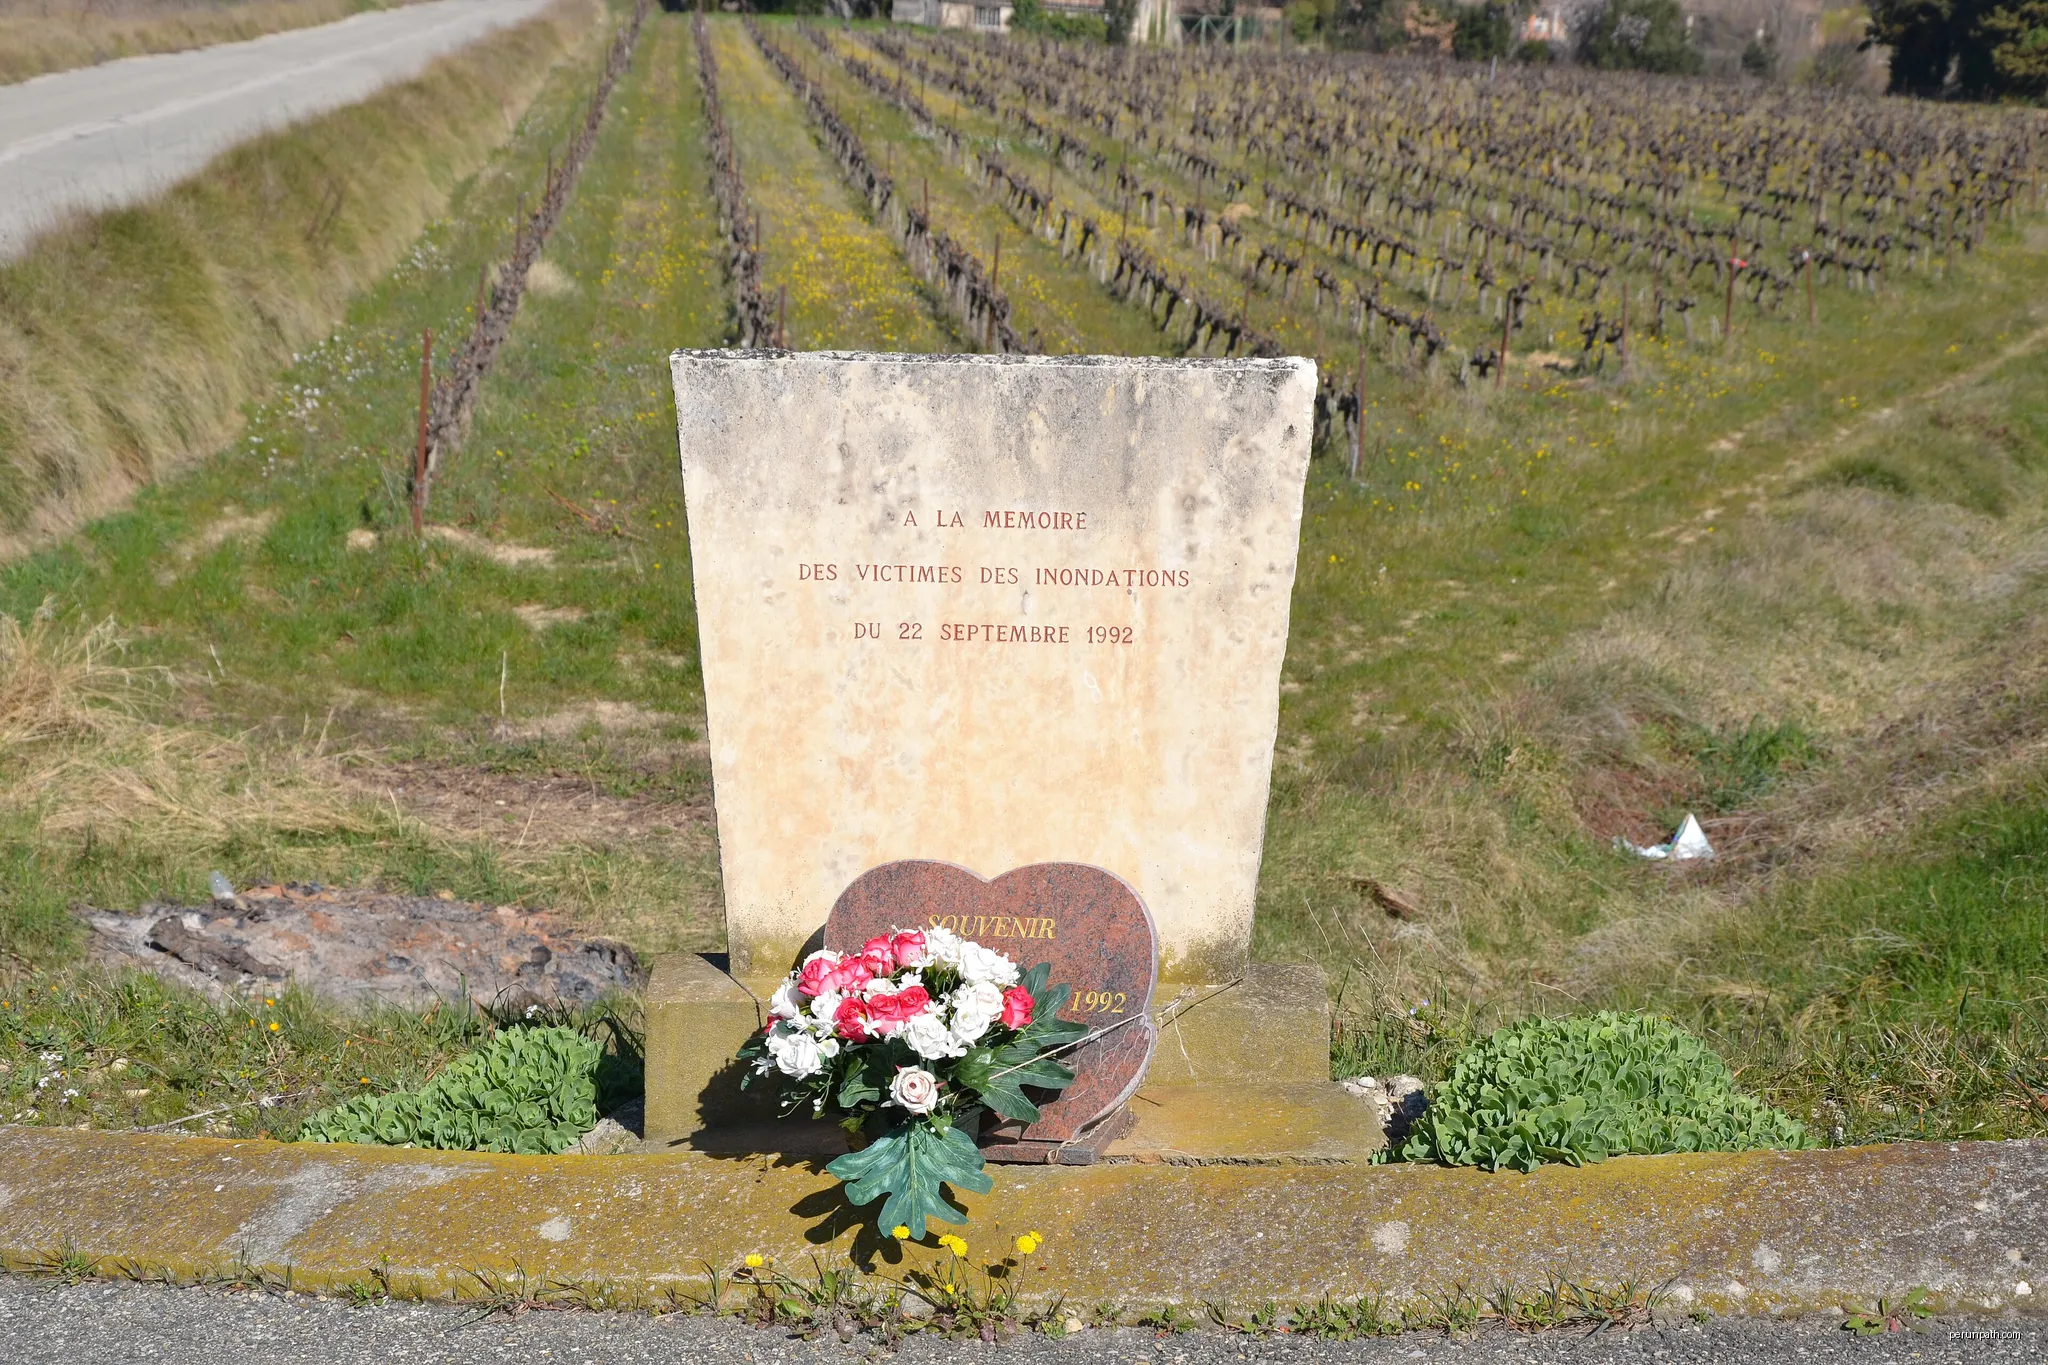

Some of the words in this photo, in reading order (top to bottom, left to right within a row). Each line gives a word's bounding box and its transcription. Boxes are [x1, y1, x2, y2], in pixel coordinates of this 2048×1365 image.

[903, 511, 918, 527] A
[936, 510, 964, 528] LA
[983, 510, 1087, 530] MEMOIRE
[799, 564, 838, 581] DES
[856, 565, 962, 583] VICTIMES
[980, 567, 1019, 585] DES
[1036, 568, 1189, 587] INONDATIONS
[854, 623, 881, 639] DU
[899, 623, 923, 640] 22
[940, 624, 1069, 643] SEPTEMBRE
[1087, 627, 1133, 644] 1992
[1071, 991, 1127, 1014] 1992
